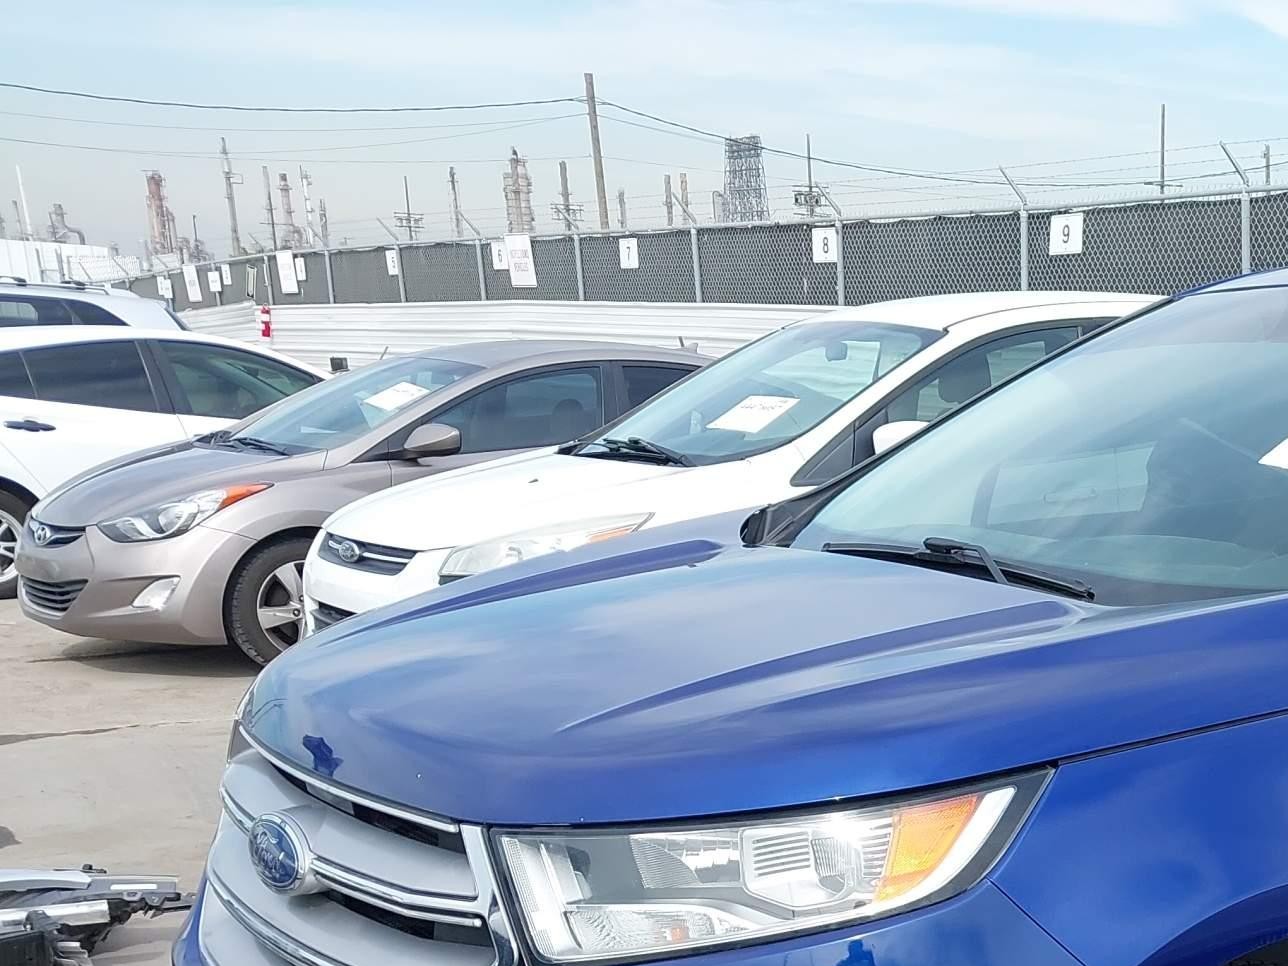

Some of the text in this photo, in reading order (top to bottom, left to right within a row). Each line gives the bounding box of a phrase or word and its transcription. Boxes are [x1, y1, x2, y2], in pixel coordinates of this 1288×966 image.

[1062, 224, 1070, 244] 9
[822, 236, 829, 254] 8
[497, 249, 503, 263] 6
[626, 246, 631, 261] 7
